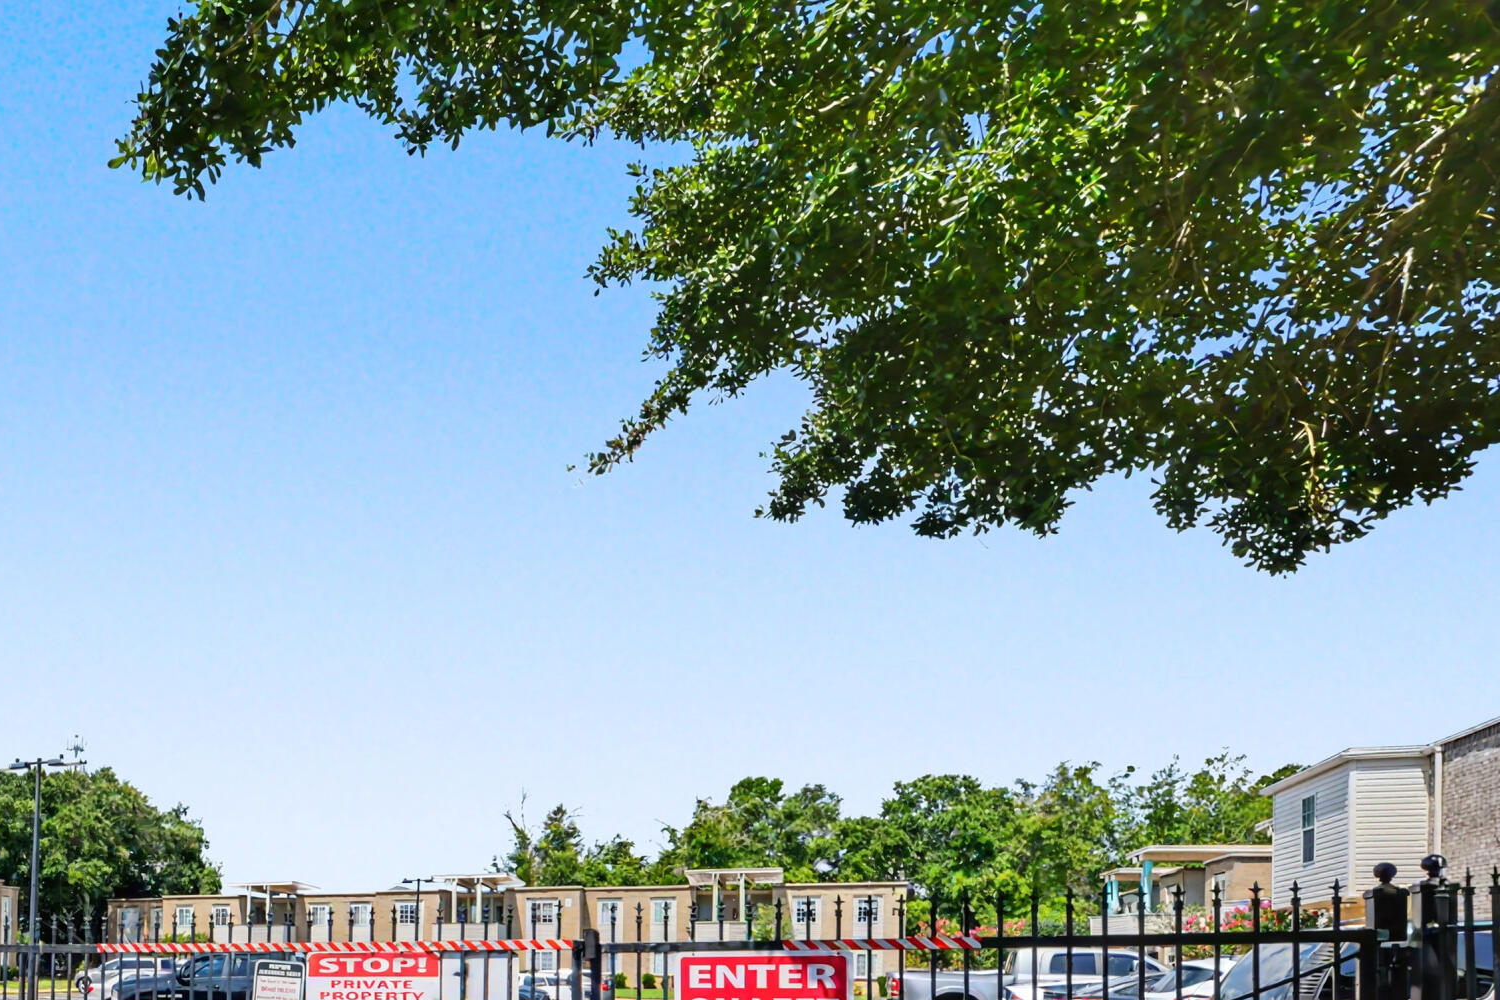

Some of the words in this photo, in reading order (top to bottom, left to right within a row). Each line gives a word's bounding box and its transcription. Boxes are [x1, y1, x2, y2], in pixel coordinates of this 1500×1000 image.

[318, 957, 428, 974] STOP!
[688, 963, 837, 990] ENTER
[331, 980, 413, 990] PRIVATE
[319, 991, 425, 1000] PROPERTY
